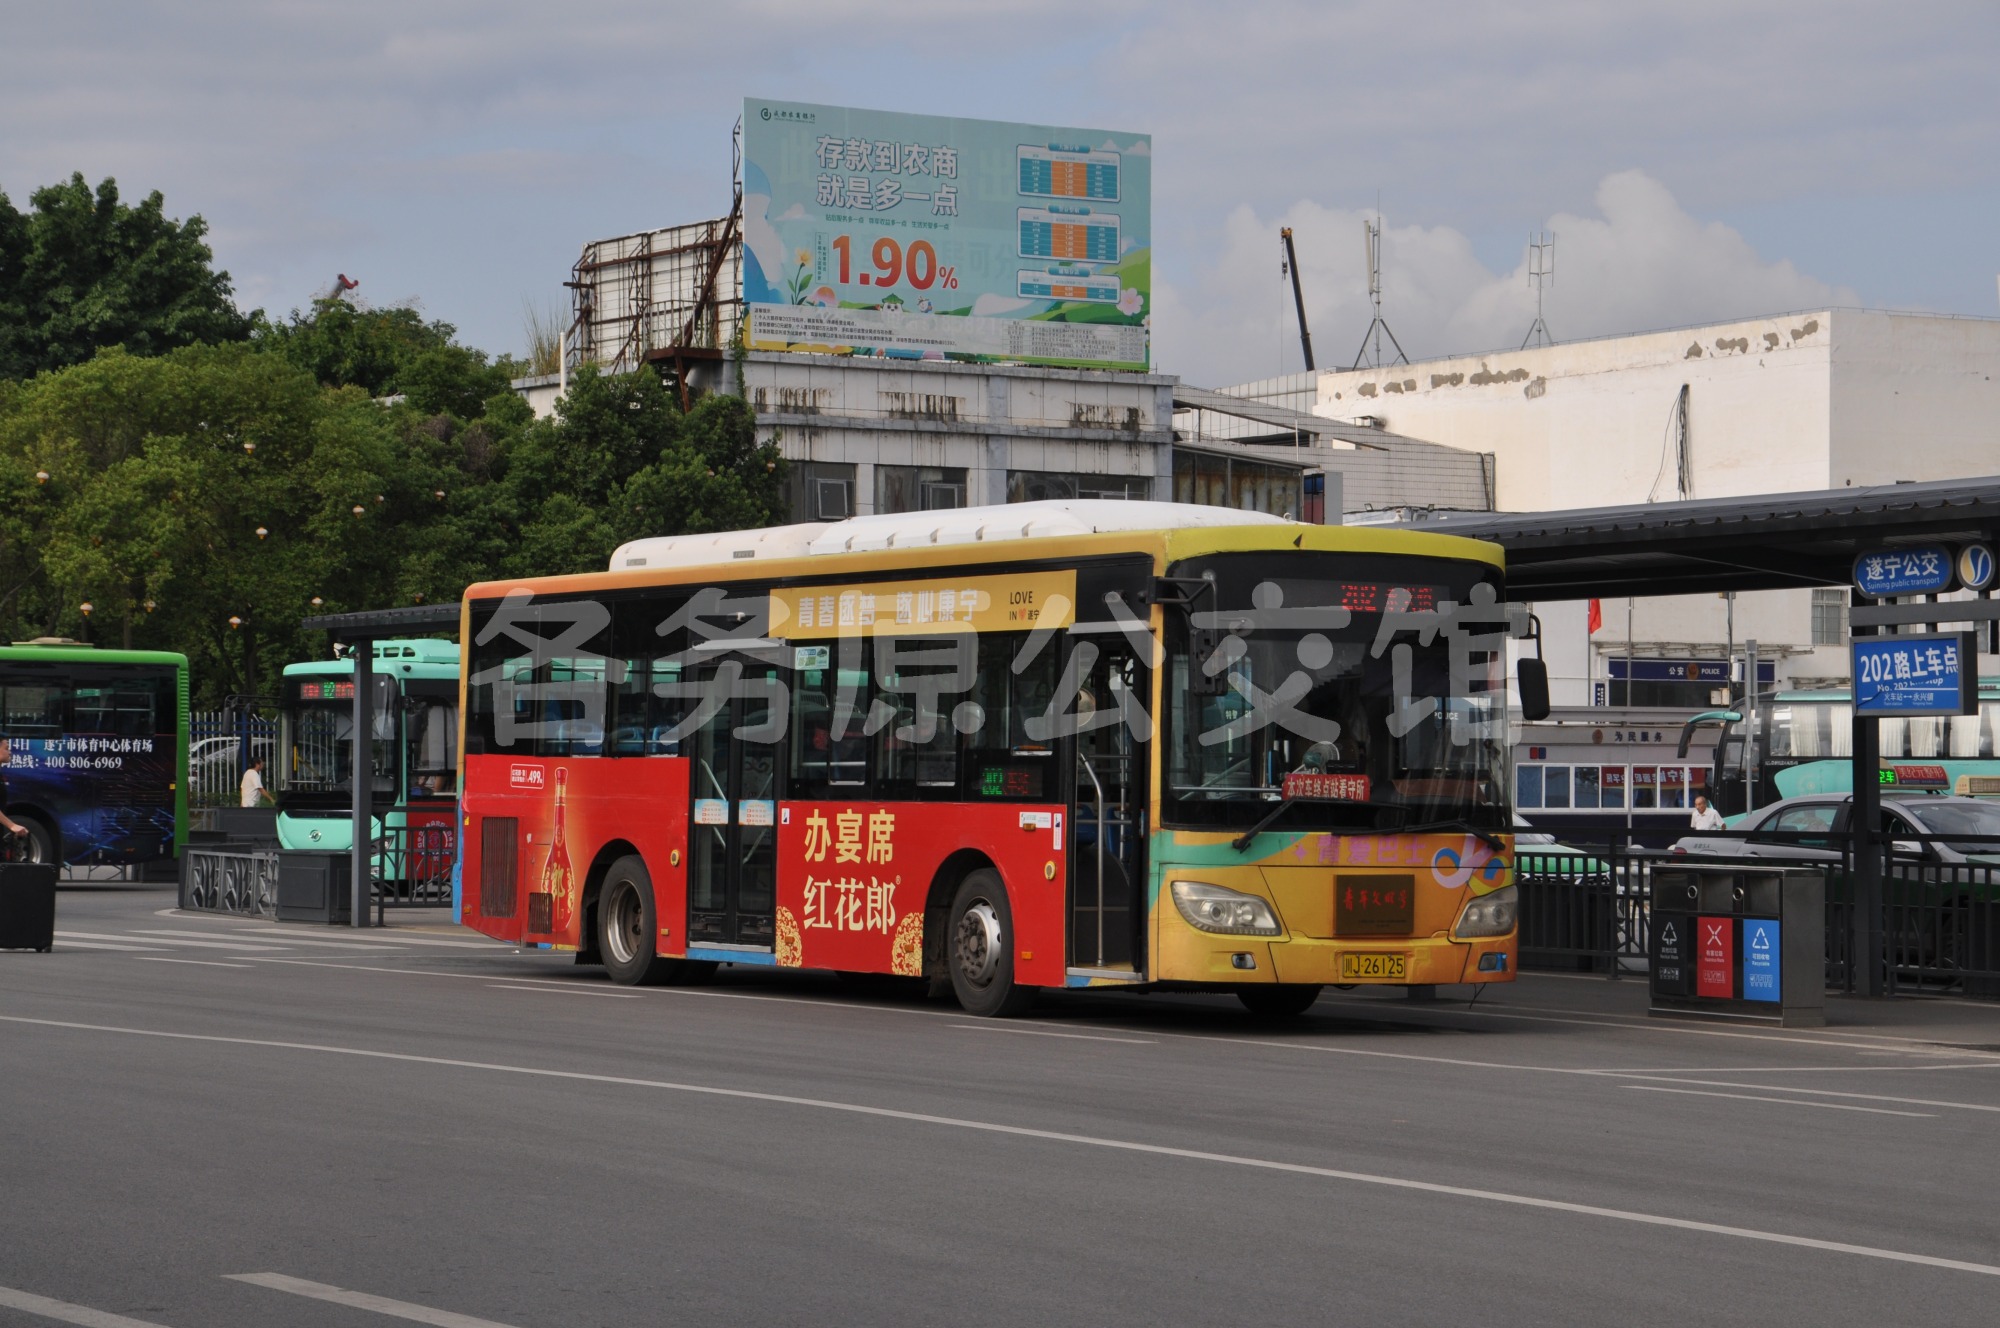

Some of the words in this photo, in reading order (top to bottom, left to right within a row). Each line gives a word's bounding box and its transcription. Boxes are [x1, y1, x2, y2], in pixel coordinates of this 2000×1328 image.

[816, 135, 959, 179] 存款到农商
[816, 173, 959, 217] 就是多一点
[832, 234, 959, 290] 1.90%
[1865, 551, 1940, 582] 遂宁公交
[1867, 581, 1890, 591] Suining
[1890, 579, 1910, 589] public
[1911, 576, 1940, 588] transport
[1010, 591, 1033, 605] LOVE
[1009, 611, 1018, 621] IN
[1668, 666, 1684, 677] 公安
[1701, 667, 1721, 676] POLICE
[1860, 645, 1959, 684] 202路上车点
[1434, 711, 1460, 721] POICE
[44, 738, 153, 753] 遂宁市体育中心体育场
[1614, 731, 1663, 743] 为民服务
[1897, 766, 1945, 779] 美纪元整形
[1286, 776, 1365, 801] 本次车终点站看守所
[804, 808, 896, 865] 办宴席
[803, 874, 896, 935] 红花郎
